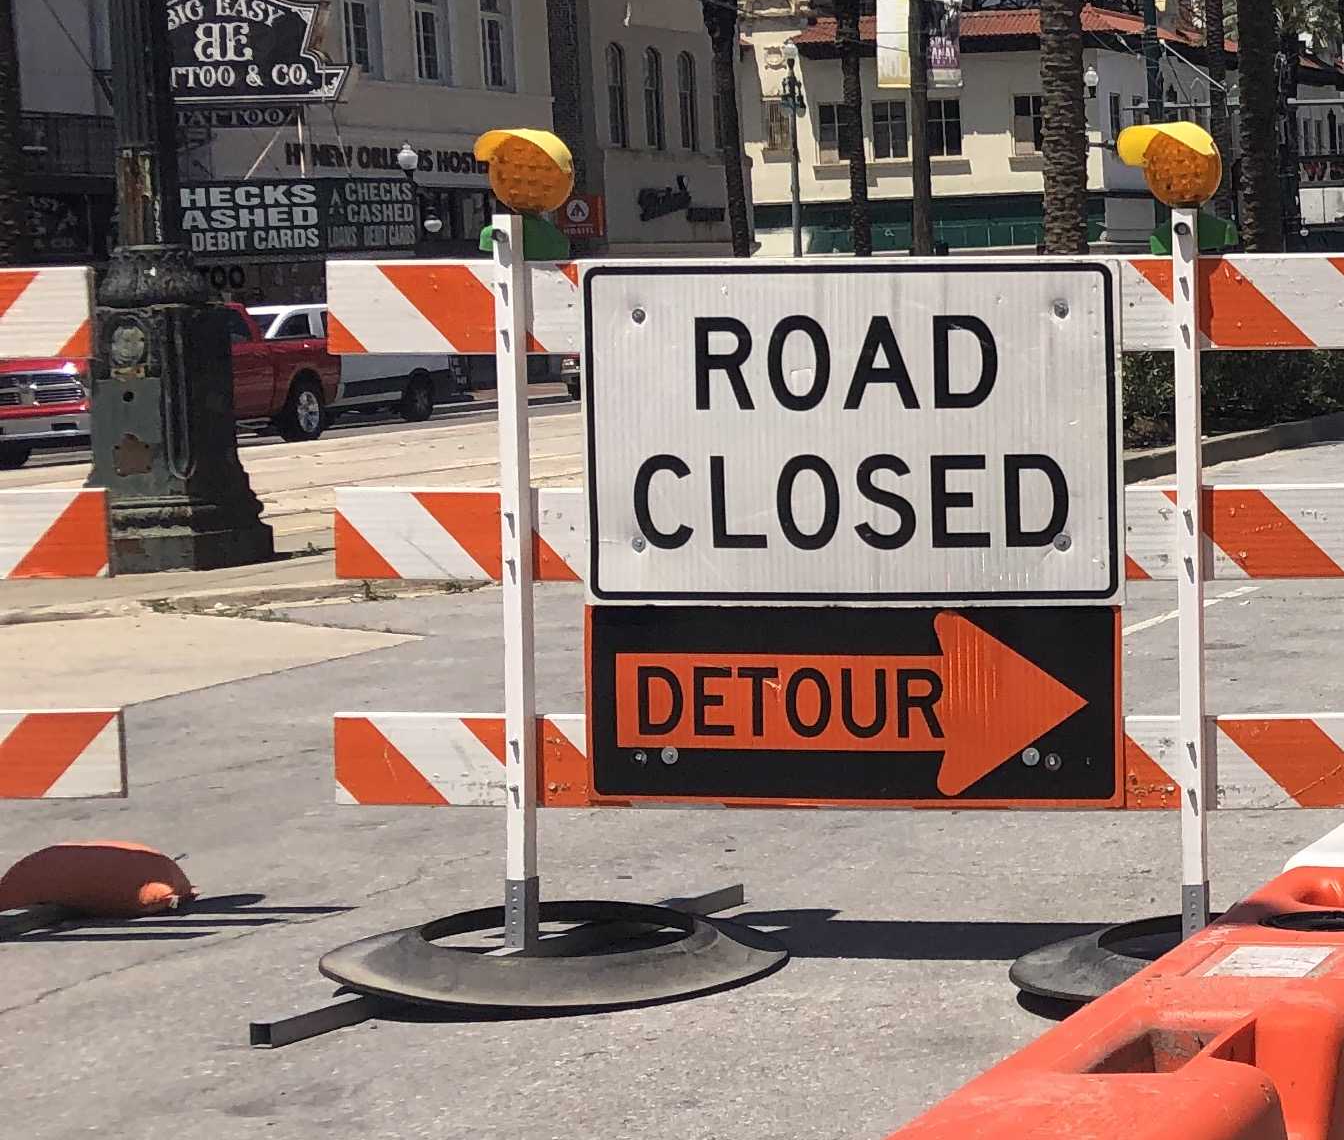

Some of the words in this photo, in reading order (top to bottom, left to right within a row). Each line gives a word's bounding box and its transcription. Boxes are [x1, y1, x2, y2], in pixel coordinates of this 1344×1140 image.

[246, 64, 264, 87] &
[180, 184, 316, 208] HECKS
[345, 182, 412, 202] CHECKS
[181, 206, 319, 230] ASHED
[347, 203, 414, 223] CASHED
[191, 231, 248, 253] DEBIT
[253, 228, 320, 250] CARDS
[694, 315, 999, 412] ROAD
[633, 453, 1070, 551] CLOSED
[636, 665, 944, 739] DETOUR
